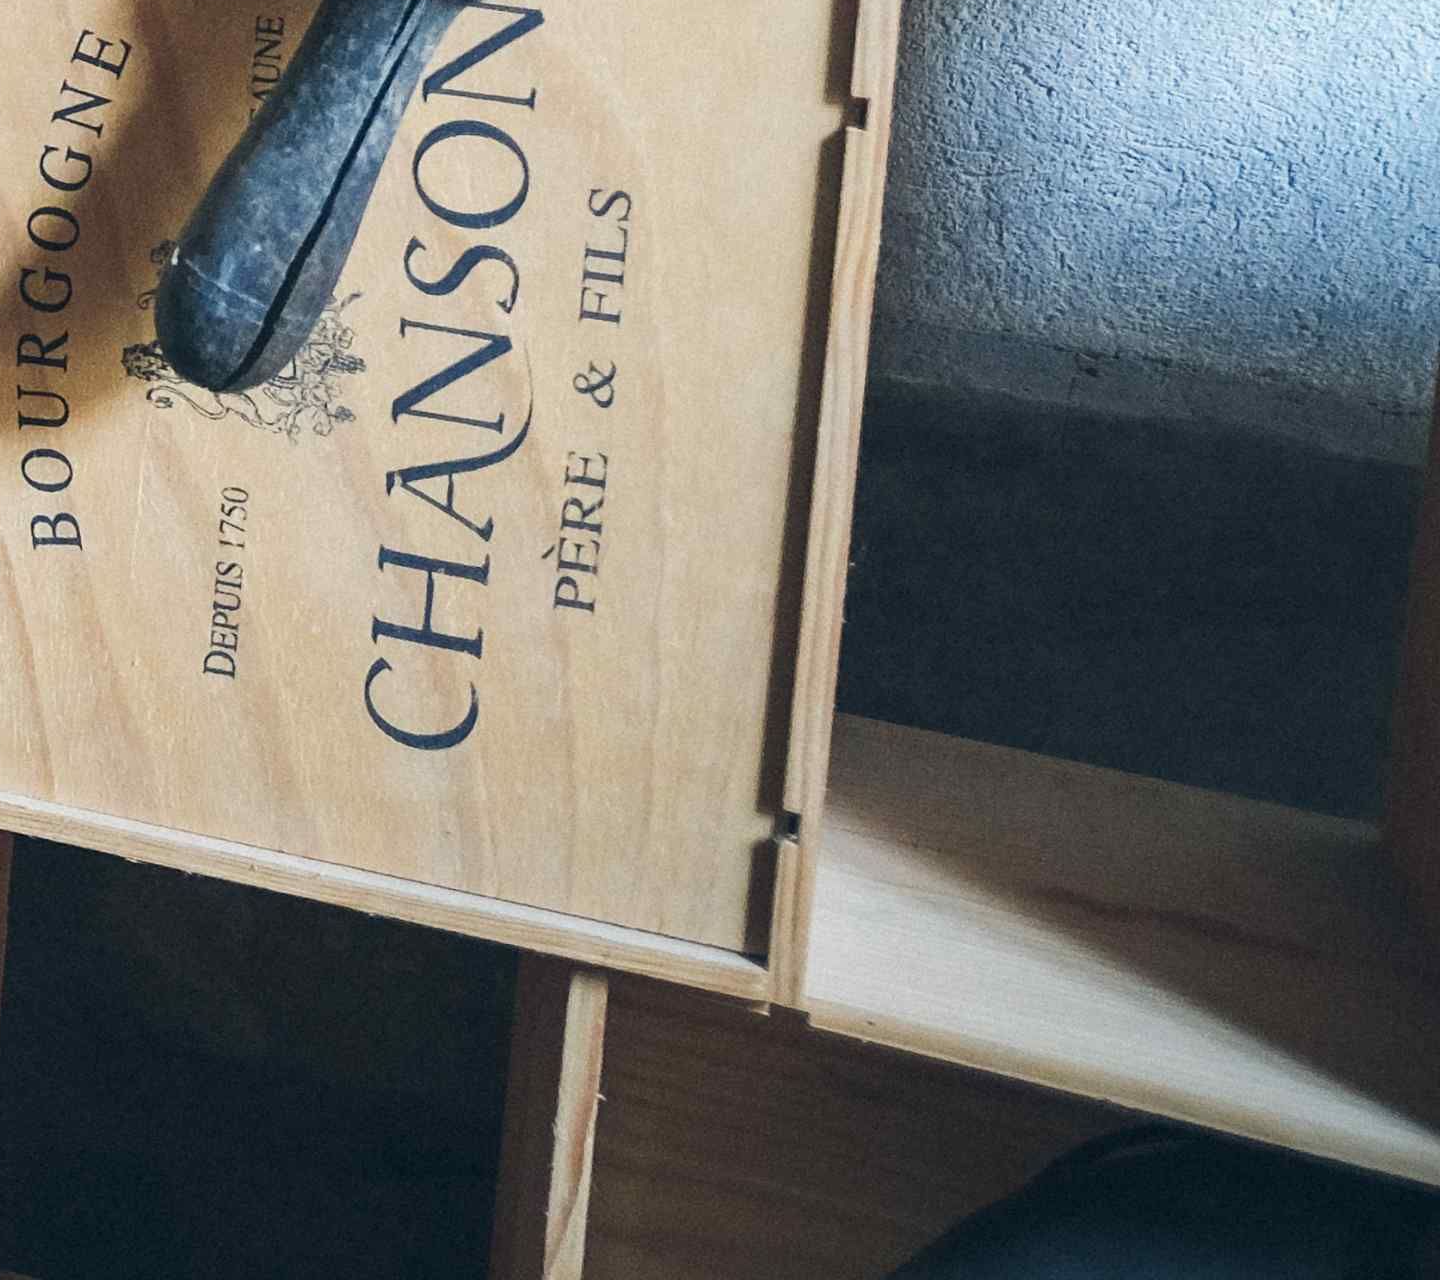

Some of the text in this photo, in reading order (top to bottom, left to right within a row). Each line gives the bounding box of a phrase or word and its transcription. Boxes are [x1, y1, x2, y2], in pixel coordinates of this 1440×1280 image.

[15, 28, 136, 553] BOURGOGNE
[538, 183, 634, 616] PÈRE & FILS
[201, 483, 251, 681] DEPUIS 1750
